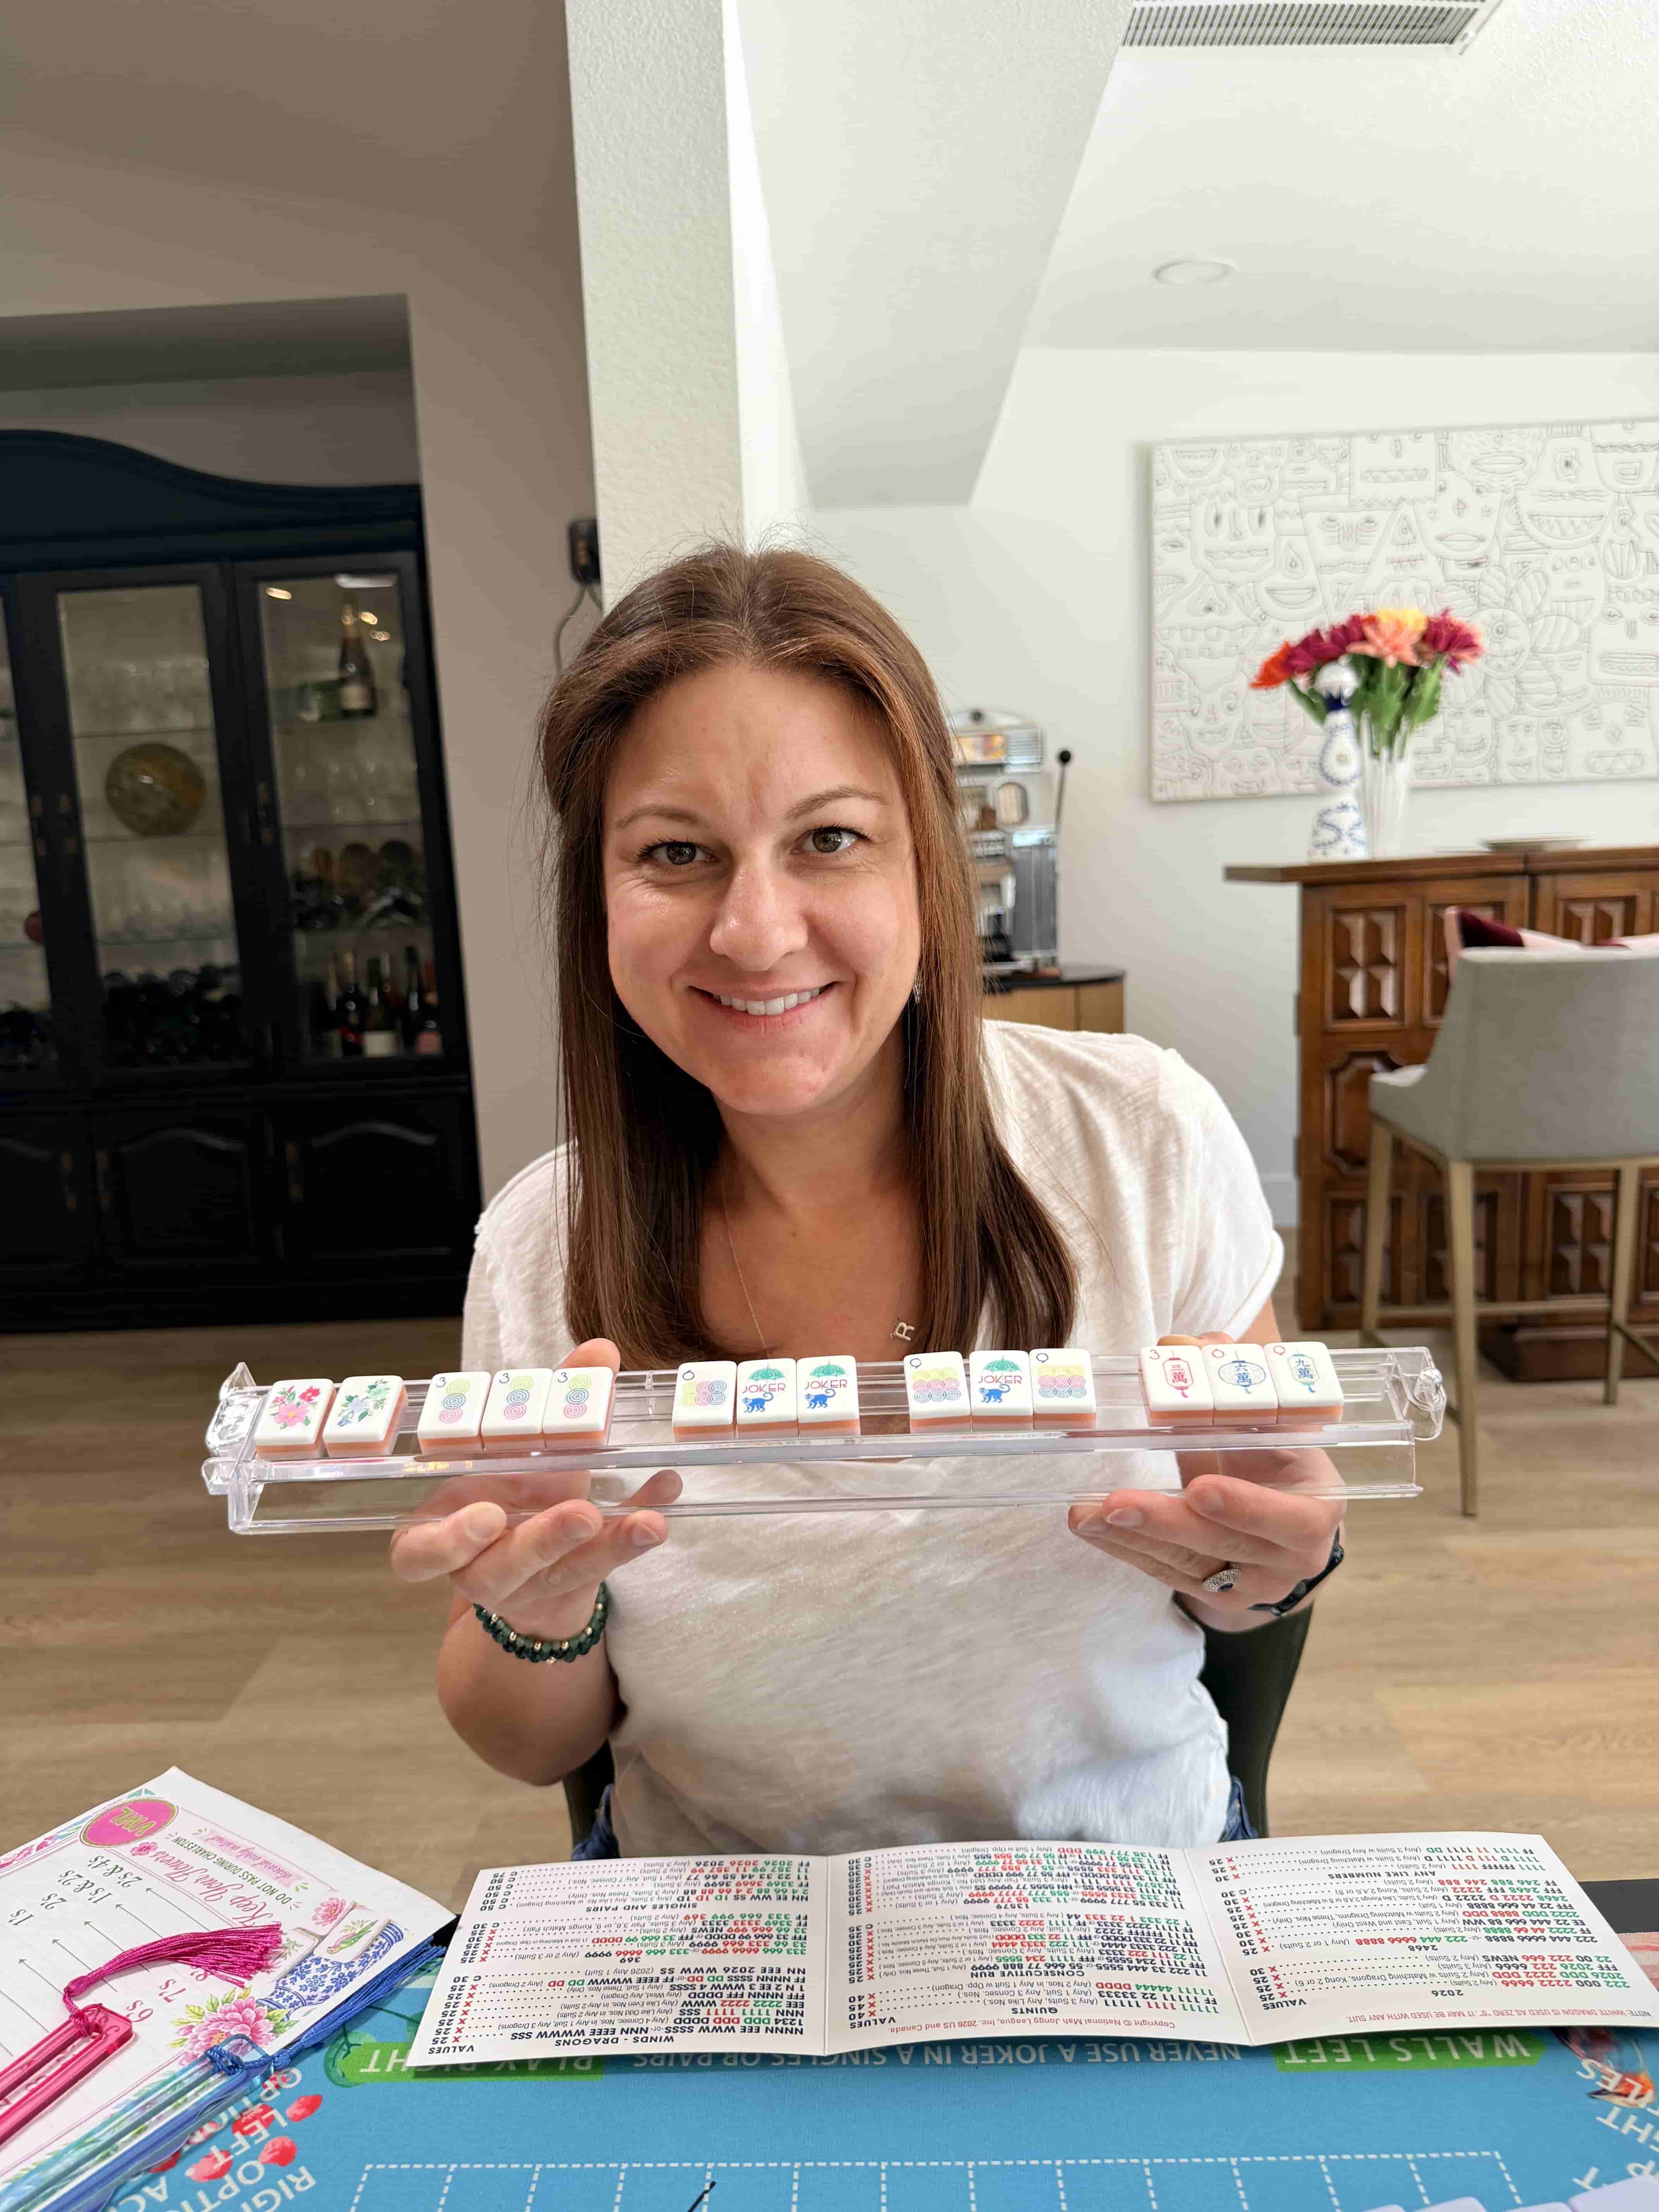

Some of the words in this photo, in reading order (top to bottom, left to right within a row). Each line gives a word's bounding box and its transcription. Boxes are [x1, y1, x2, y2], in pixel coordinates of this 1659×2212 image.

[1149, 1349, 1160, 1360] 3
[1211, 1348, 1225, 1358] 6
[1273, 1345, 1286, 1356] 9
[910, 1358, 922, 1369] 9
[1036, 1353, 1048, 1363] 9
[1170, 1364, 1187, 1384] 三萬
[1234, 1363, 1252, 1385] 六萬
[1295, 1358, 1314, 1380] 九萬
[499, 1373, 509, 1384] 3
[558, 1372, 568, 1383] 3
[682, 1370, 695, 1381] 6
[977, 1375, 1023, 1384] JOKER
[436, 1377, 446, 1388] 3
[742, 1382, 787, 1394] JOKER
[804, 1379, 848, 1390] JOKER
[172, 1836, 217, 1861] CHARLESTON
[87, 1855, 111, 1869] 4's
[150, 1850, 207, 1882] Flowers
[216, 1856, 243, 1875] DURING
[103, 1865, 124, 1877] &
[57, 1870, 84, 1886] 2's
[117, 1872, 143, 1887] 2's
[238, 1870, 261, 1886] PASS
[74, 1879, 95, 1893] &
[193, 1869, 244, 1901] Your
[257, 1882, 278, 1897] NOT
[40, 1893, 67, 1910] 2's
[88, 1887, 113, 1904] 1's
[275, 1893, 292, 1905] DO
[229, 1895, 273, 1926] Keep
[8, 1909, 35, 1926] 1's
[630, 1966, 654, 1975] (2026
[680, 1966, 717, 1975] WWW
[970, 1971, 994, 1979] RUN
[1250, 1968, 1265, 1976] 30
[1252, 1976, 1269, 1985] 25
[158, 1978, 186, 2003] 7's
[688, 1991, 723, 1999] DDDD
[748, 1991, 783, 1999] NNNN
[787, 1992, 805, 2000] FFF
[1146, 2001, 1176, 2010] 1111
[1262, 1999, 1307, 2010] VALUES
[126, 2000, 154, 2023] 6's
[849, 2012, 866, 2021] 40
[850, 2017, 896, 2029] VALUES
[888, 2025, 922, 2033] Canada.
[1134, 2020, 1175, 2028] Copyright
[555, 2037, 619, 2046] DRAGONS
[428, 2045, 474, 2054] VALUES
[960, 2044, 1049, 2064] JOKER
[1056, 2044, 1077, 2063] A
[1084, 2042, 1140, 2063] USE
[1147, 2040, 1243, 2062] NEVER
[1285, 2039, 1375, 2064] LEFT
[1389, 2035, 1531, 2061] WALLS
[722, 2053, 760, 2066] OR
[896, 2045, 914, 2065] A
[923, 2045, 951, 2065] IN
[210, 2108, 287, 2169] LEFT
[168, 2160, 265, 2212] OPTI
